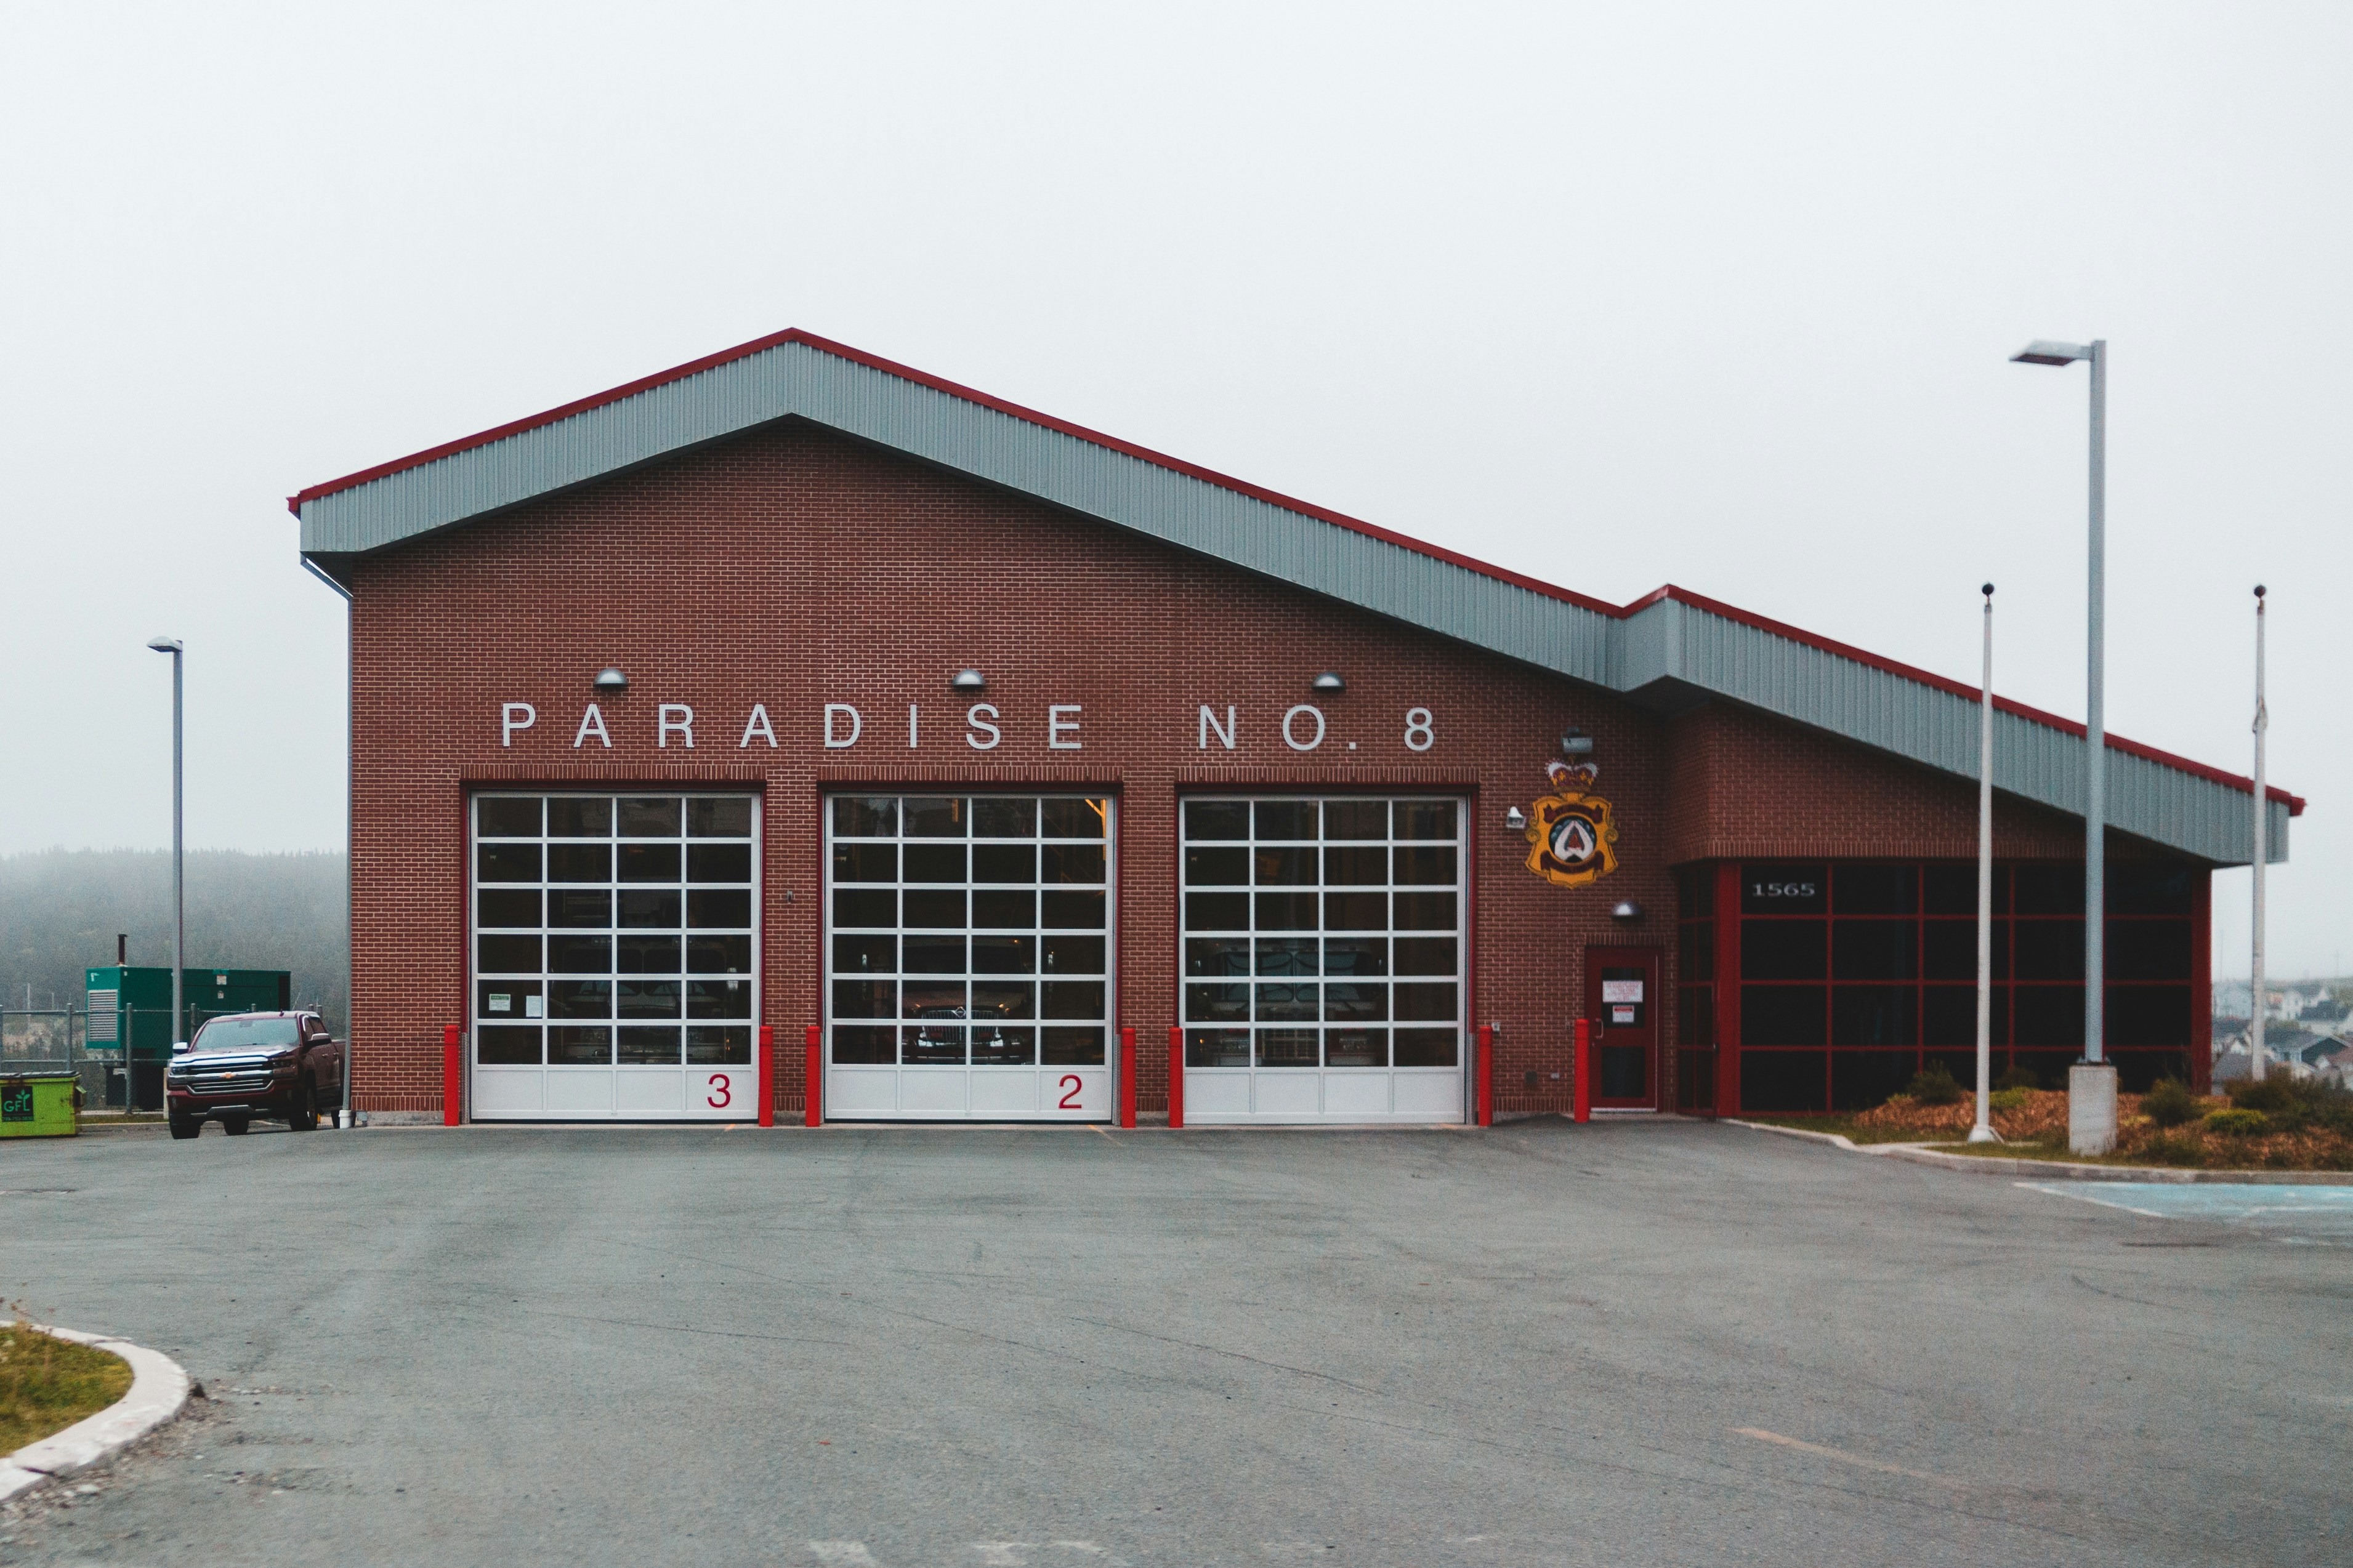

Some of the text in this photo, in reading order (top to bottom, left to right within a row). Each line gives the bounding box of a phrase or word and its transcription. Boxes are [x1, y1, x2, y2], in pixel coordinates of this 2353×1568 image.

[502, 702, 1435, 751] PARADISE NO. 8
[1752, 883, 1815, 897] 1565
[4, 1094, 30, 1112] GFL
[707, 1074, 731, 1108] 3
[1058, 1074, 1082, 1109] 2
